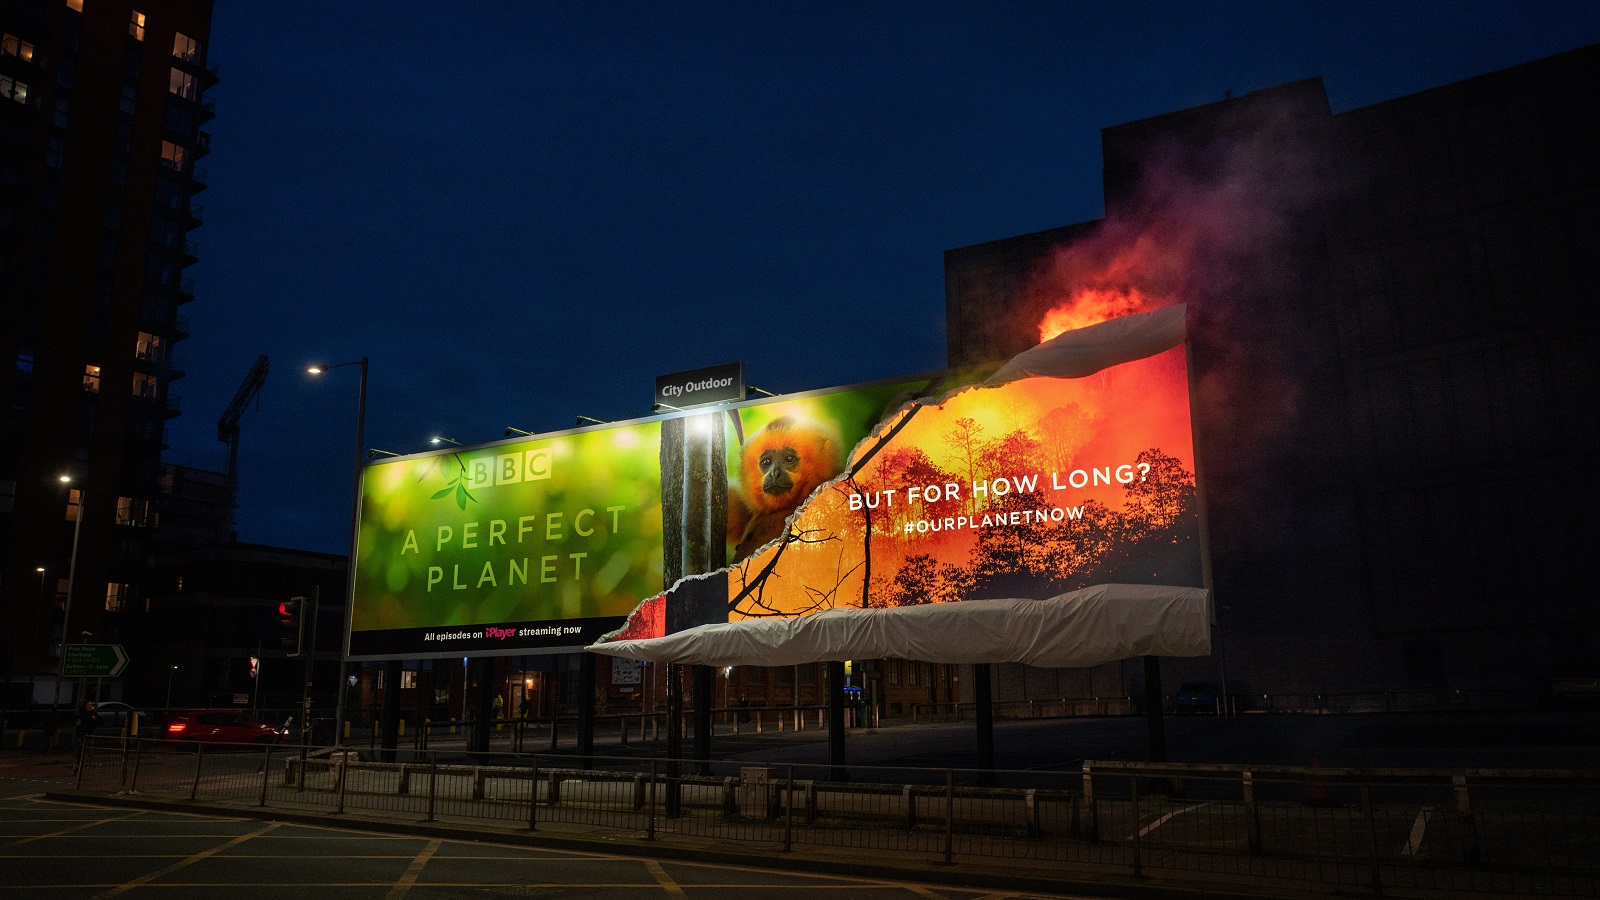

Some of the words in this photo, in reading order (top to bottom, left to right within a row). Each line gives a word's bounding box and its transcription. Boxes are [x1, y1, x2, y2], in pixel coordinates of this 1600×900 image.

[661, 384, 684, 397] City
[685, 377, 733, 393] Outdoor
[473, 451, 548, 486] BBC
[848, 489, 897, 511] BUT
[907, 482, 960, 505] FOR
[971, 473, 1040, 498] HOW
[1051, 462, 1152, 491] LONG?
[400, 529, 420, 556] A
[436, 505, 626, 552] PERFECT
[903, 505, 1086, 535] #OURPLANETNOW
[427, 552, 588, 593] PLANET
[424, 631, 435, 642] All
[436, 630, 471, 642] episodes
[472, 631, 483, 639] on
[485, 627, 517, 640] iPlayer
[519, 626, 562, 637] streaming
[563, 626, 582, 635] now
